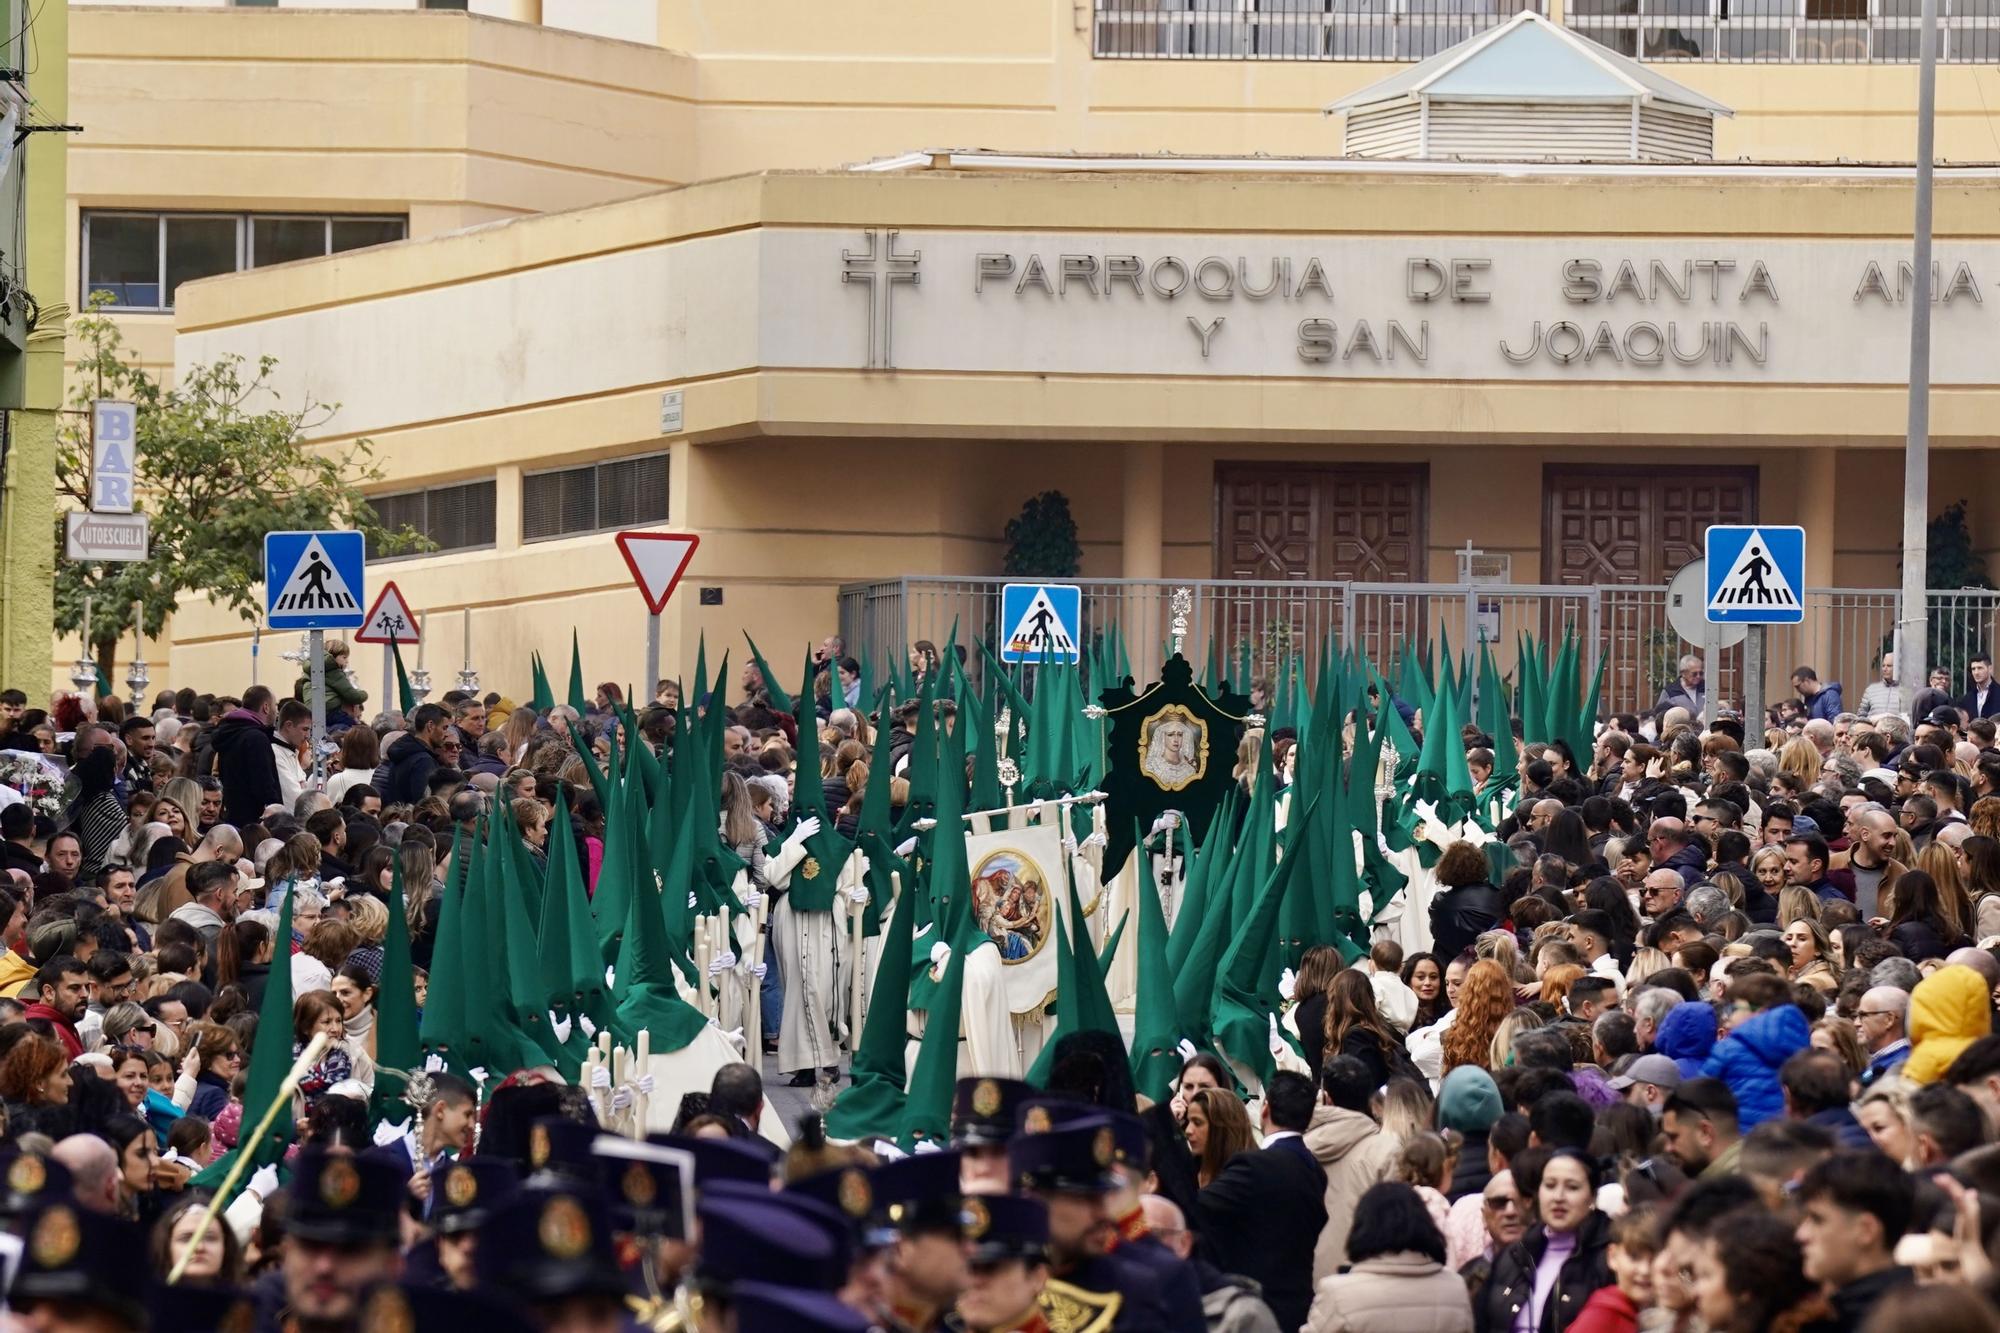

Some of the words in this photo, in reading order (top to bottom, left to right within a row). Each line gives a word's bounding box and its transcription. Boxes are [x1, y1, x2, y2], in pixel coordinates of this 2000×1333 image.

[975, 253, 1334, 300] PARROQUIA
[1406, 257, 1491, 302] DE
[1562, 258, 1779, 302] SANTA
[1853, 260, 1982, 303] ANA
[1186, 316, 1226, 358] Y
[1296, 318, 1428, 364] SAN
[1500, 320, 1768, 364] JOAQUIN
[97, 410, 131, 506] BAR
[80, 527, 141, 545] AUTOESCUELA
